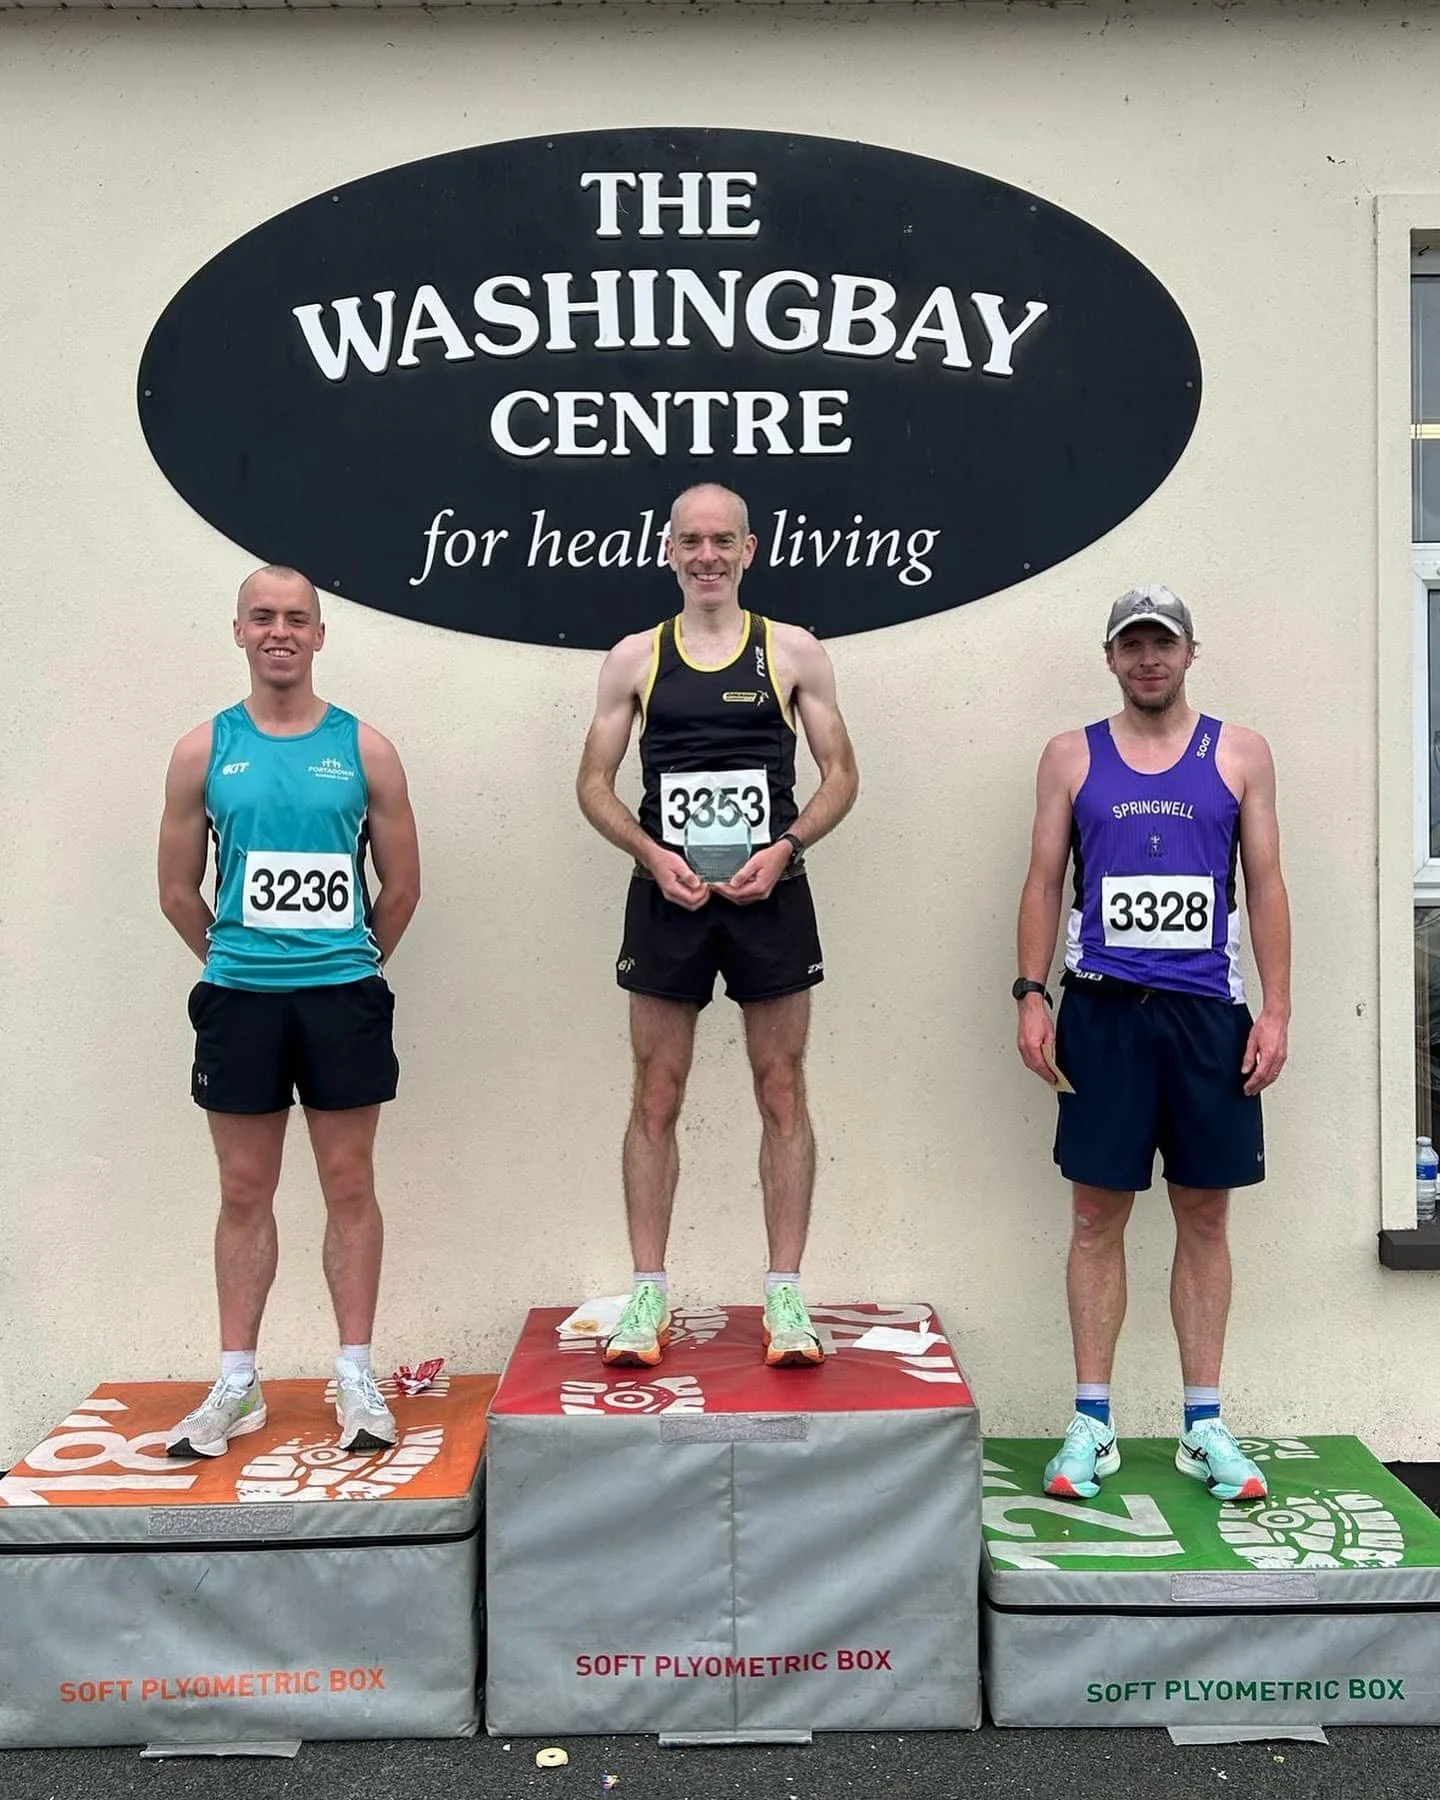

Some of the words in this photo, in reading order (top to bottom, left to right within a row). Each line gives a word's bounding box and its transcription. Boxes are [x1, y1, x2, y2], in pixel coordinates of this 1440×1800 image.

[580, 171, 761, 239] THE
[292, 268, 1048, 382] WASHINGBAY
[490, 389, 852, 458] CENTRE
[409, 508, 509, 586] for
[527, 509, 673, 568] healt
[769, 509, 941, 586] living
[668, 785, 765, 830] 3353
[1112, 799, 1195, 821] SPRINGWELL
[250, 867, 349, 913] 3236
[1109, 891, 1209, 933] 3328
[59, 1678, 134, 1705] SOFT
[140, 1669, 320, 1702] PLYOMETRIC
[328, 1667, 386, 1694] BOX
[576, 1654, 648, 1677] SOFT
[655, 1651, 829, 1678] PLYOMETRIC
[837, 1649, 893, 1672] BOX
[1086, 1681, 1157, 1703] SOFT
[1165, 1679, 1341, 1703] PLYOMETRIC
[1348, 1677, 1405, 1701] BOX
